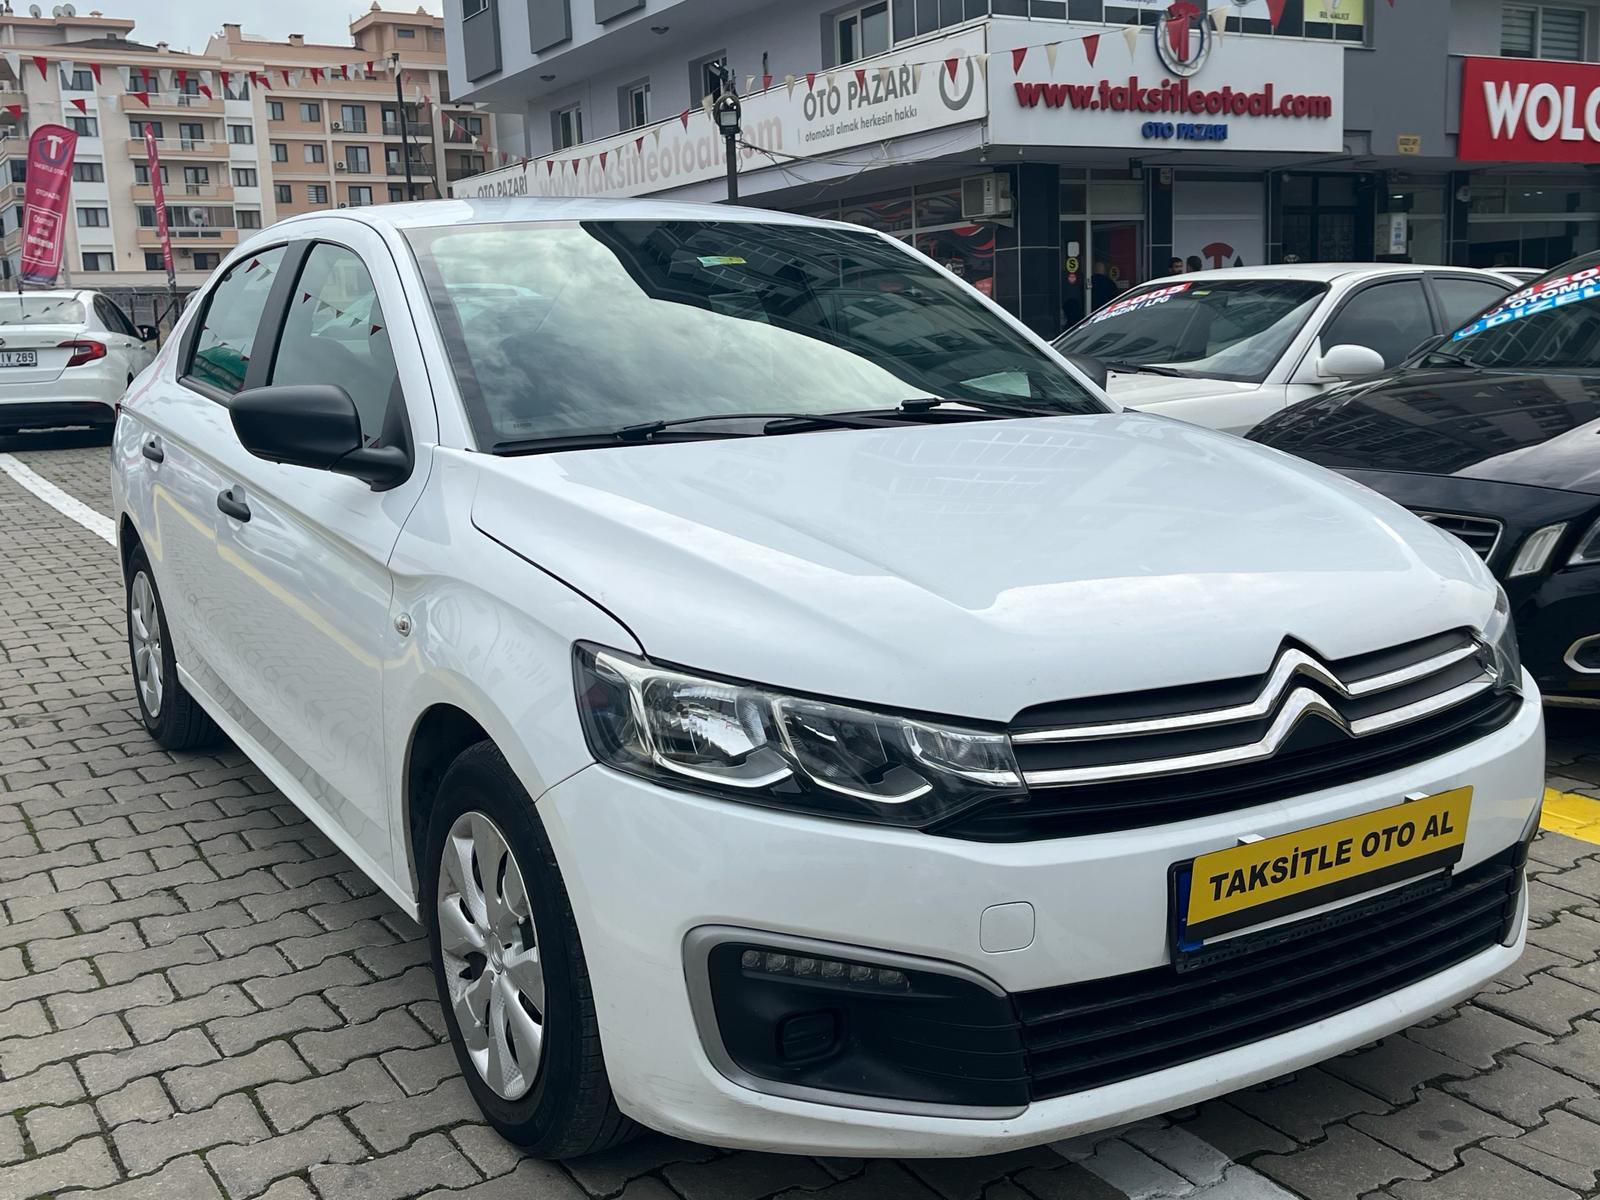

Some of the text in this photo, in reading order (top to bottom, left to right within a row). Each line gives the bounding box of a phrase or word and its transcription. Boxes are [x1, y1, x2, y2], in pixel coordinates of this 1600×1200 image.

[803, 65, 919, 121] OTO PAZARI
[1014, 76, 1332, 118] www.taksitleotoal.com
[805, 105, 918, 142] otomobil almak herkesin hakkı
[1142, 121, 1229, 142] OTO PAZARI
[477, 174, 528, 198] OTO PAZARI
[1112, 284, 1186, 308] 2005
[1209, 811, 1454, 901] TAKSİTLE OTO AL
